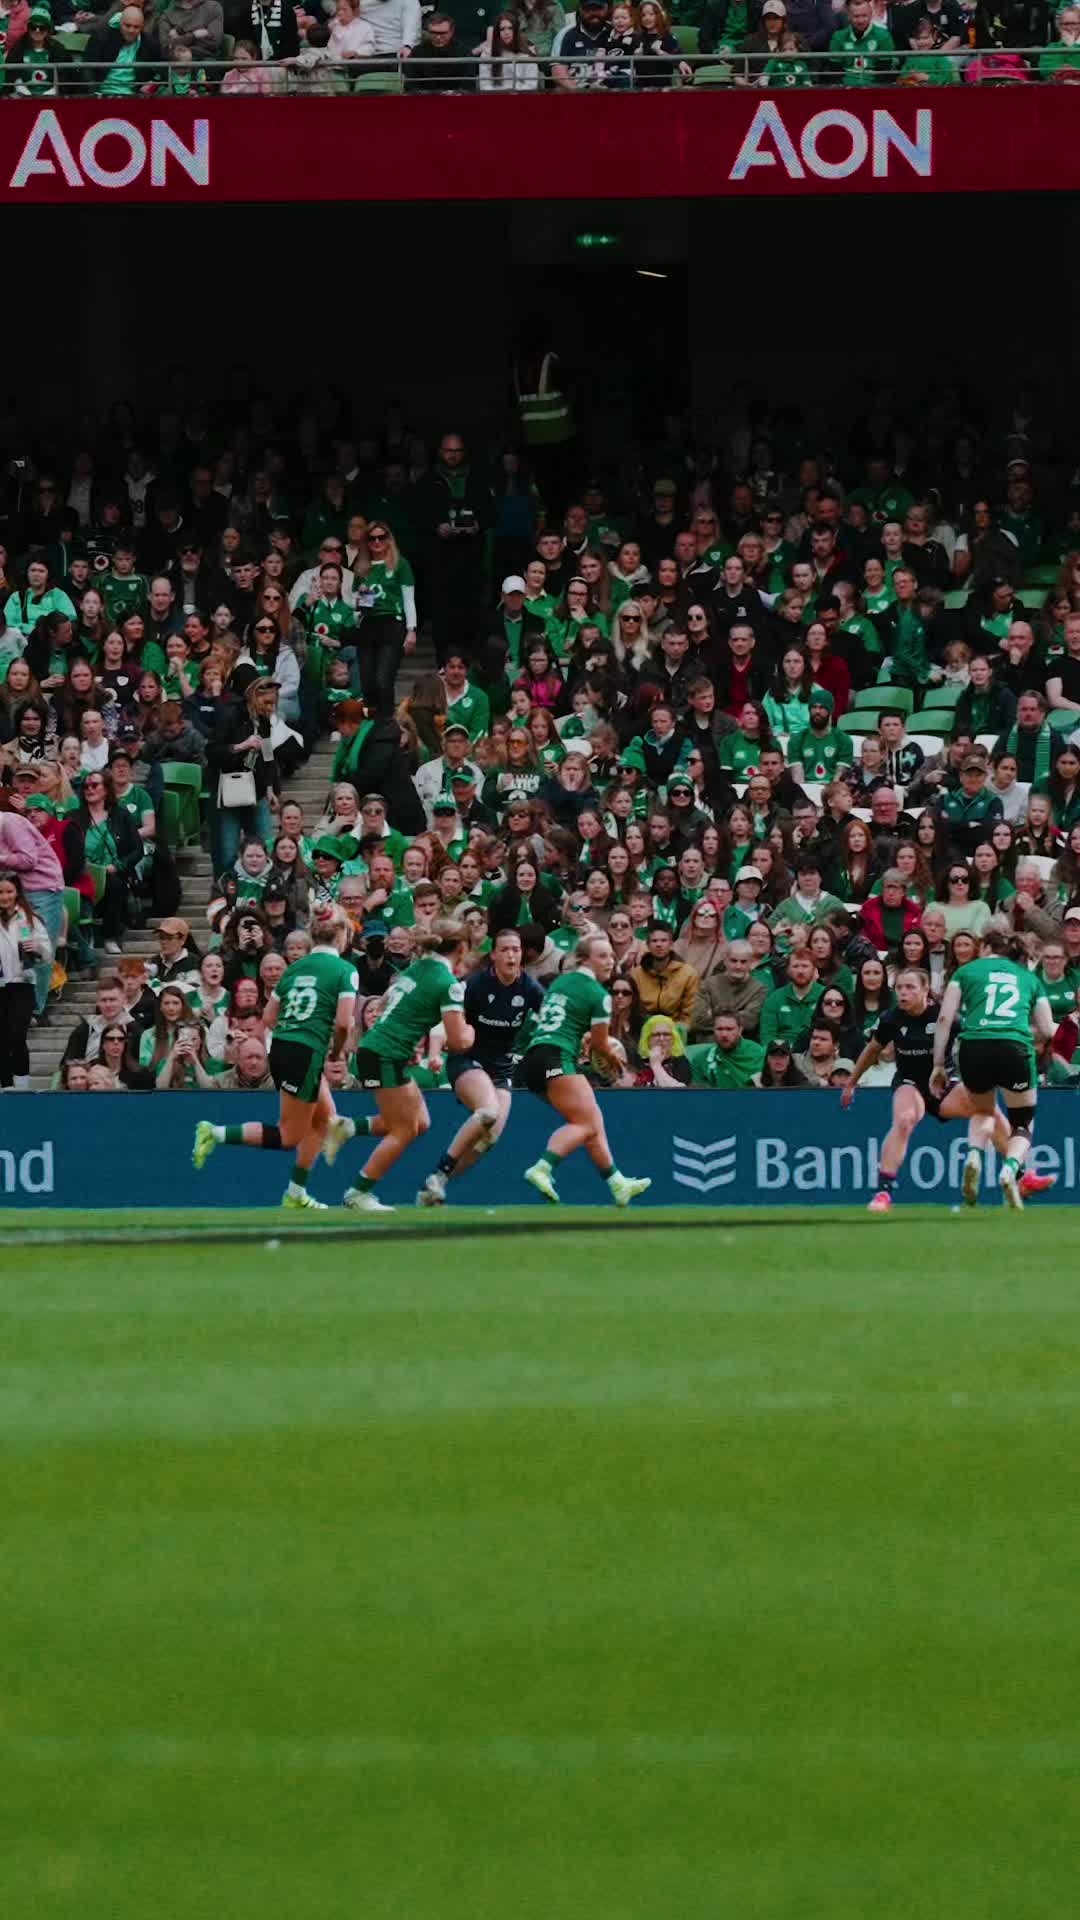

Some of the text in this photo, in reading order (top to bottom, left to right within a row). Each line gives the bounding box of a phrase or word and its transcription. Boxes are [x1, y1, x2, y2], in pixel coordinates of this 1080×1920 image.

[9, 109, 210, 188] AON
[728, 100, 933, 180] AON
[285, 987, 318, 1020] 10
[984, 983, 1020, 1018] 12
